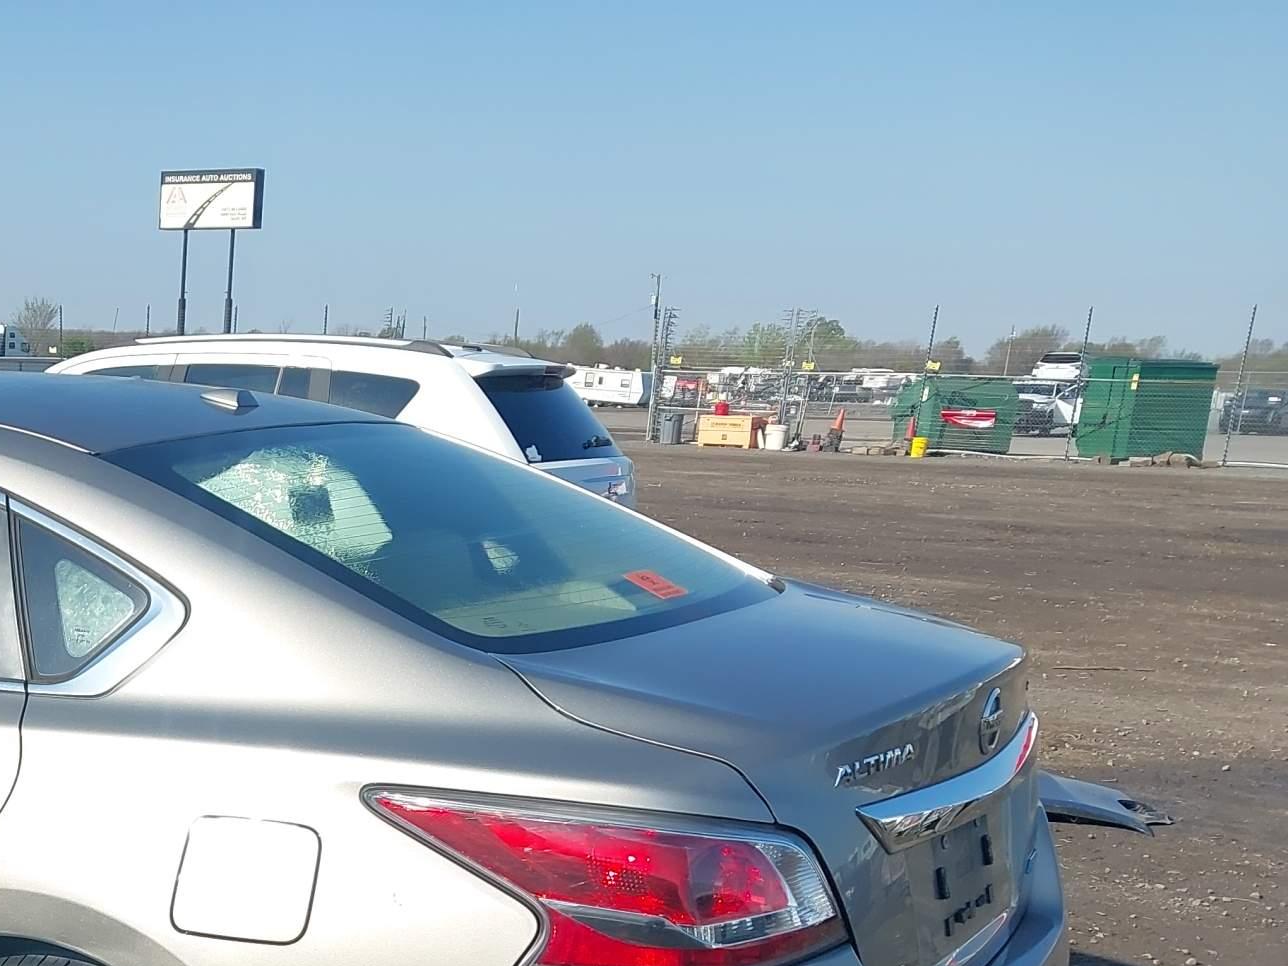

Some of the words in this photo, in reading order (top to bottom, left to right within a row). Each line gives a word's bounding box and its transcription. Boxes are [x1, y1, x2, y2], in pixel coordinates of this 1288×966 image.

[165, 174, 200, 182] INSURANCE
[201, 173, 218, 181] AUTO
[219, 173, 252, 181] AUCTIONS
[833, 743, 915, 789] ALTIMA
